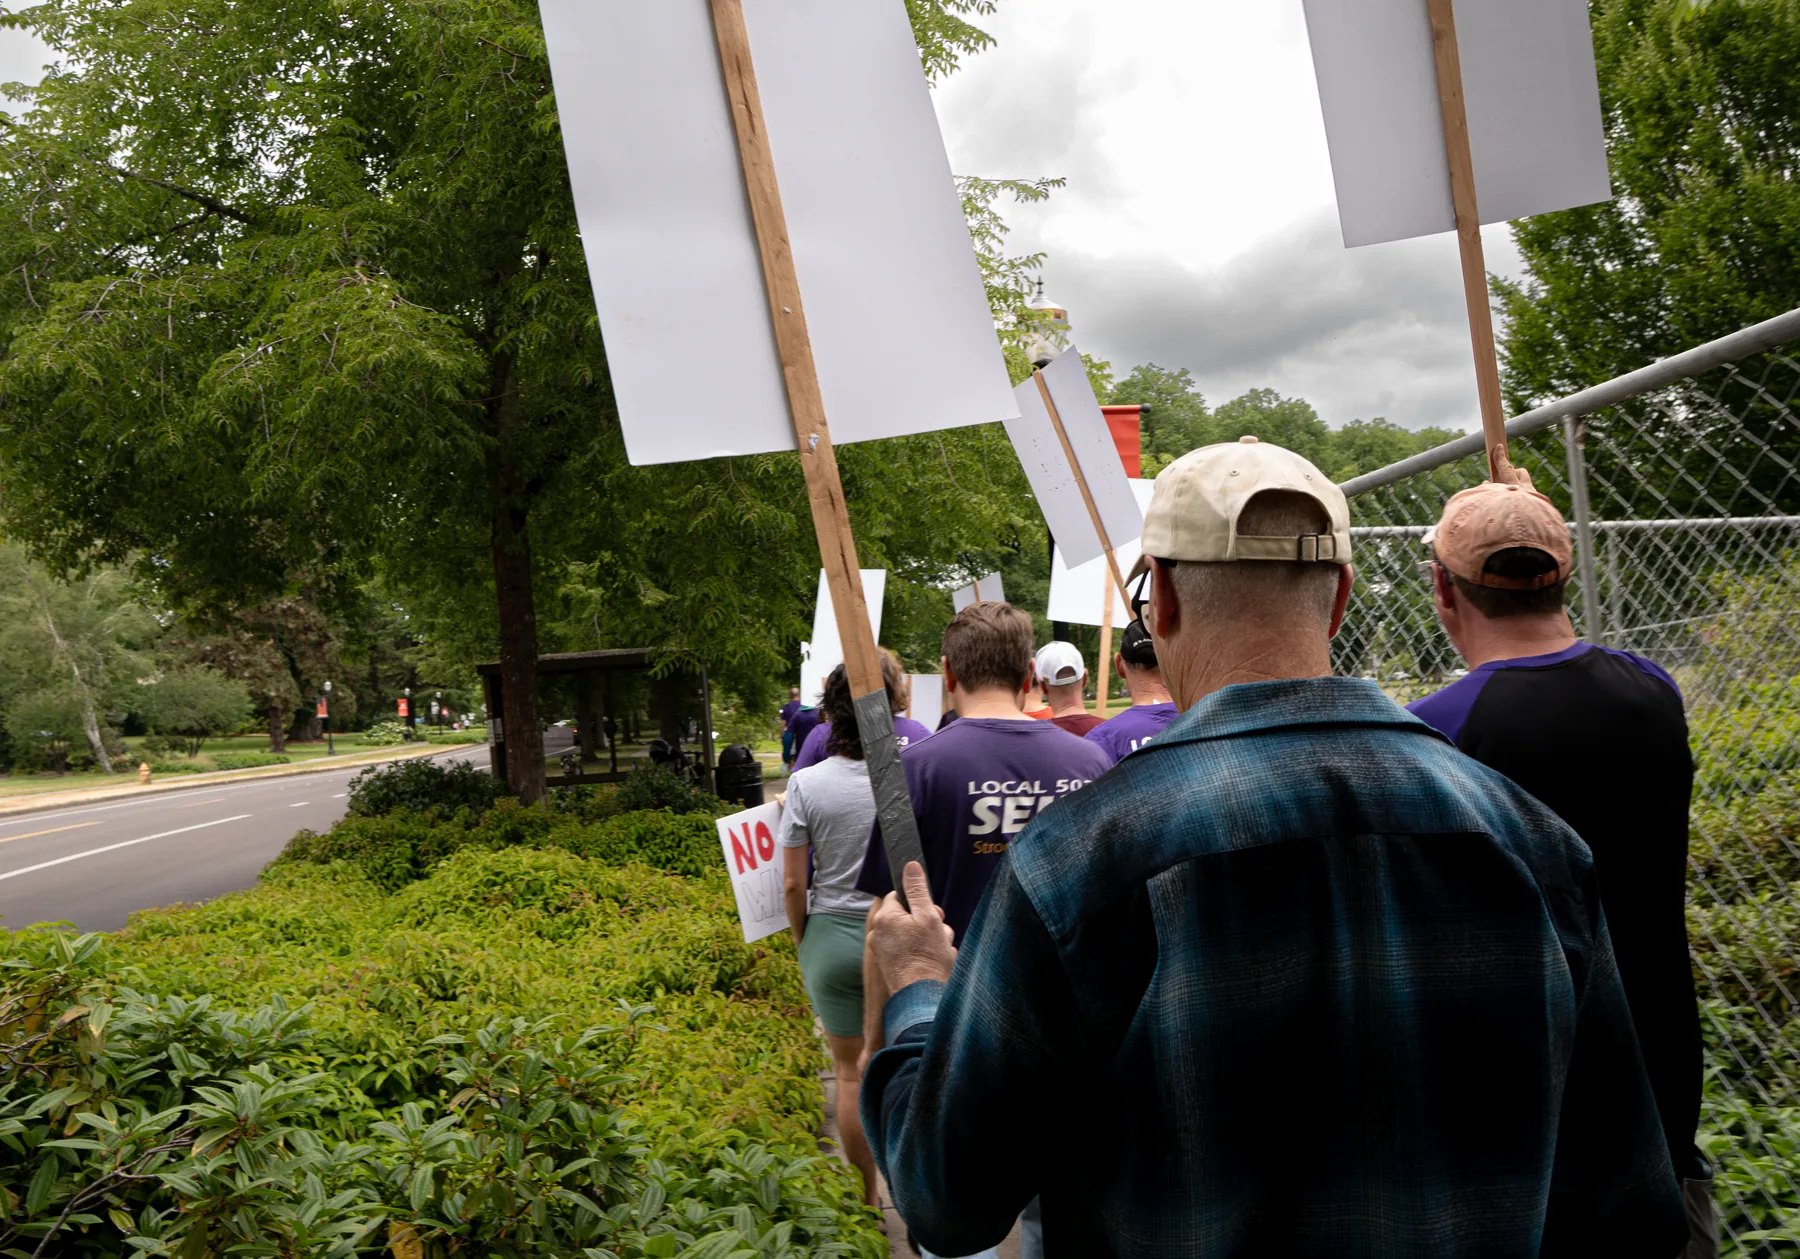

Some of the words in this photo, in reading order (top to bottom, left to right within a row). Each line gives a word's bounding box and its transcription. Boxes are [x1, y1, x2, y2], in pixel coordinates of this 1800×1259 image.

[968, 780, 1048, 795] LOCAL
[1055, 779, 1092, 793] 50
[728, 821, 775, 875] NO
[972, 840, 1008, 854] Stro
